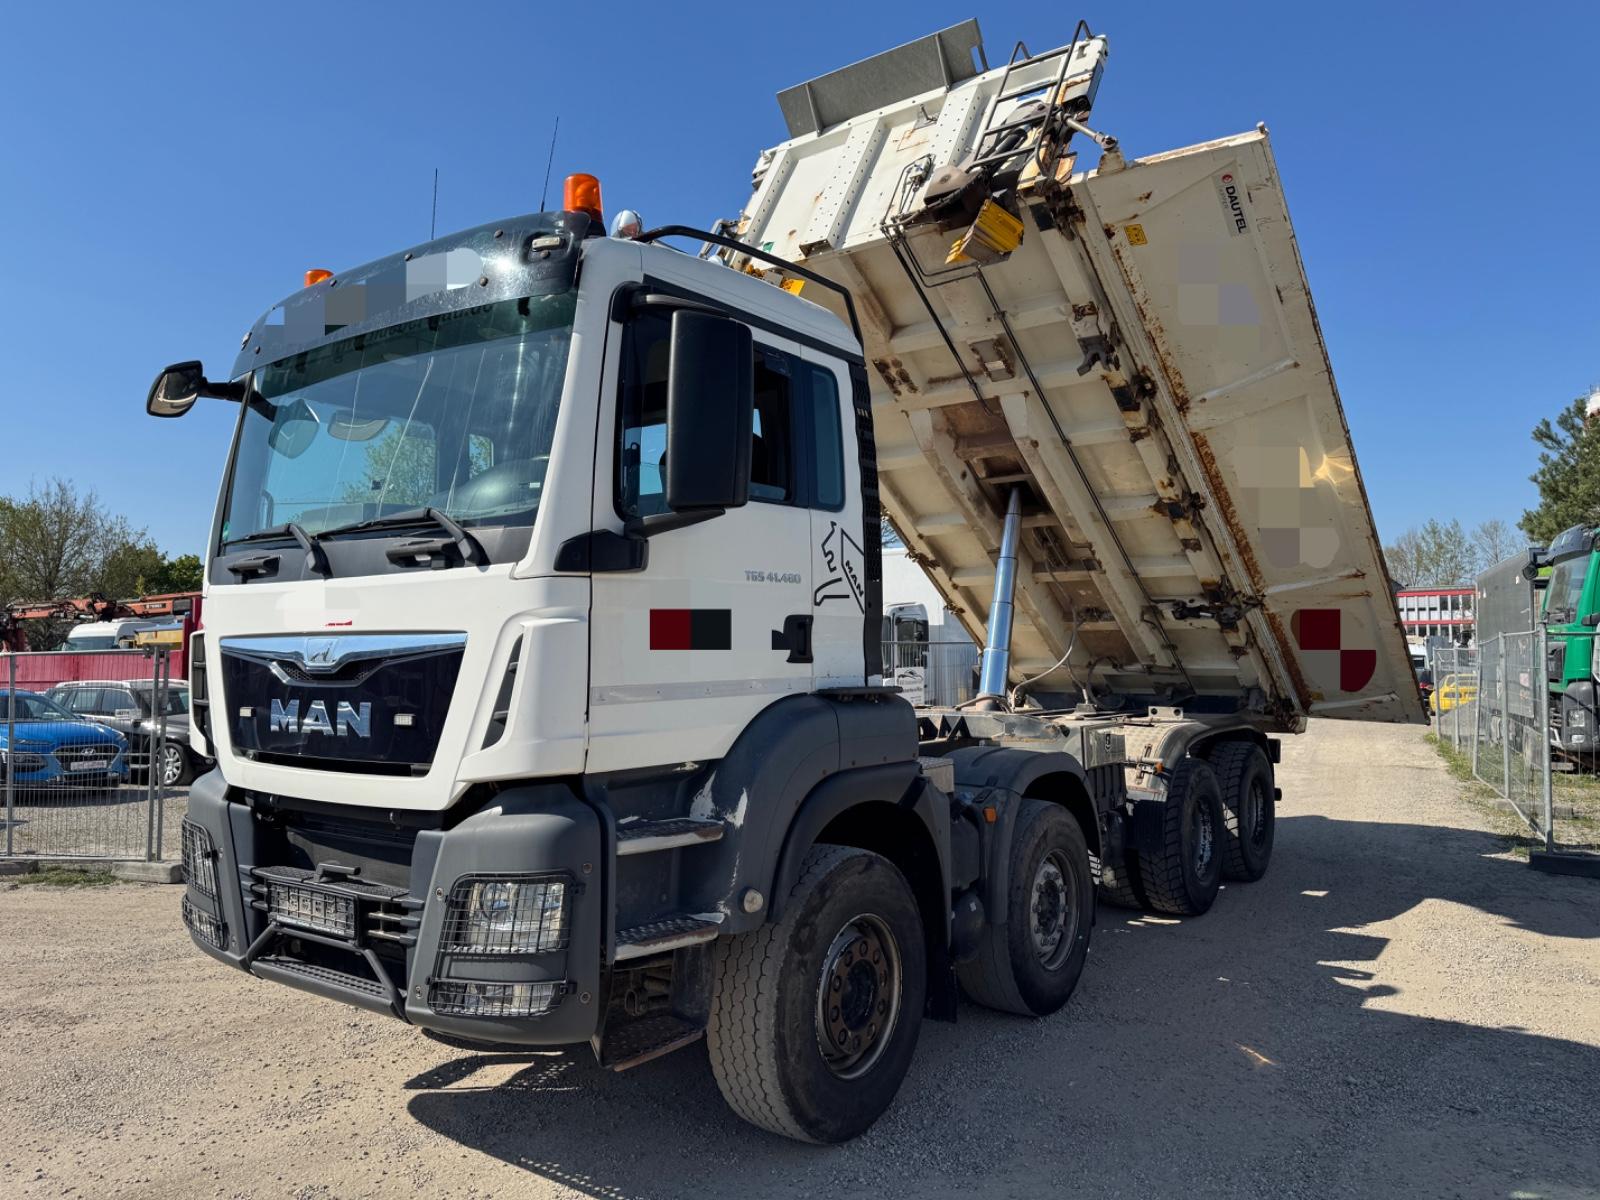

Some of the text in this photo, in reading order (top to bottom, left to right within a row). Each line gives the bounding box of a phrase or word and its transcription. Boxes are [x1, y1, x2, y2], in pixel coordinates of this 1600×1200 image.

[1225, 185, 1247, 234] DAUTEL
[845, 560, 864, 597] MAN
[270, 699, 372, 738] MAN
